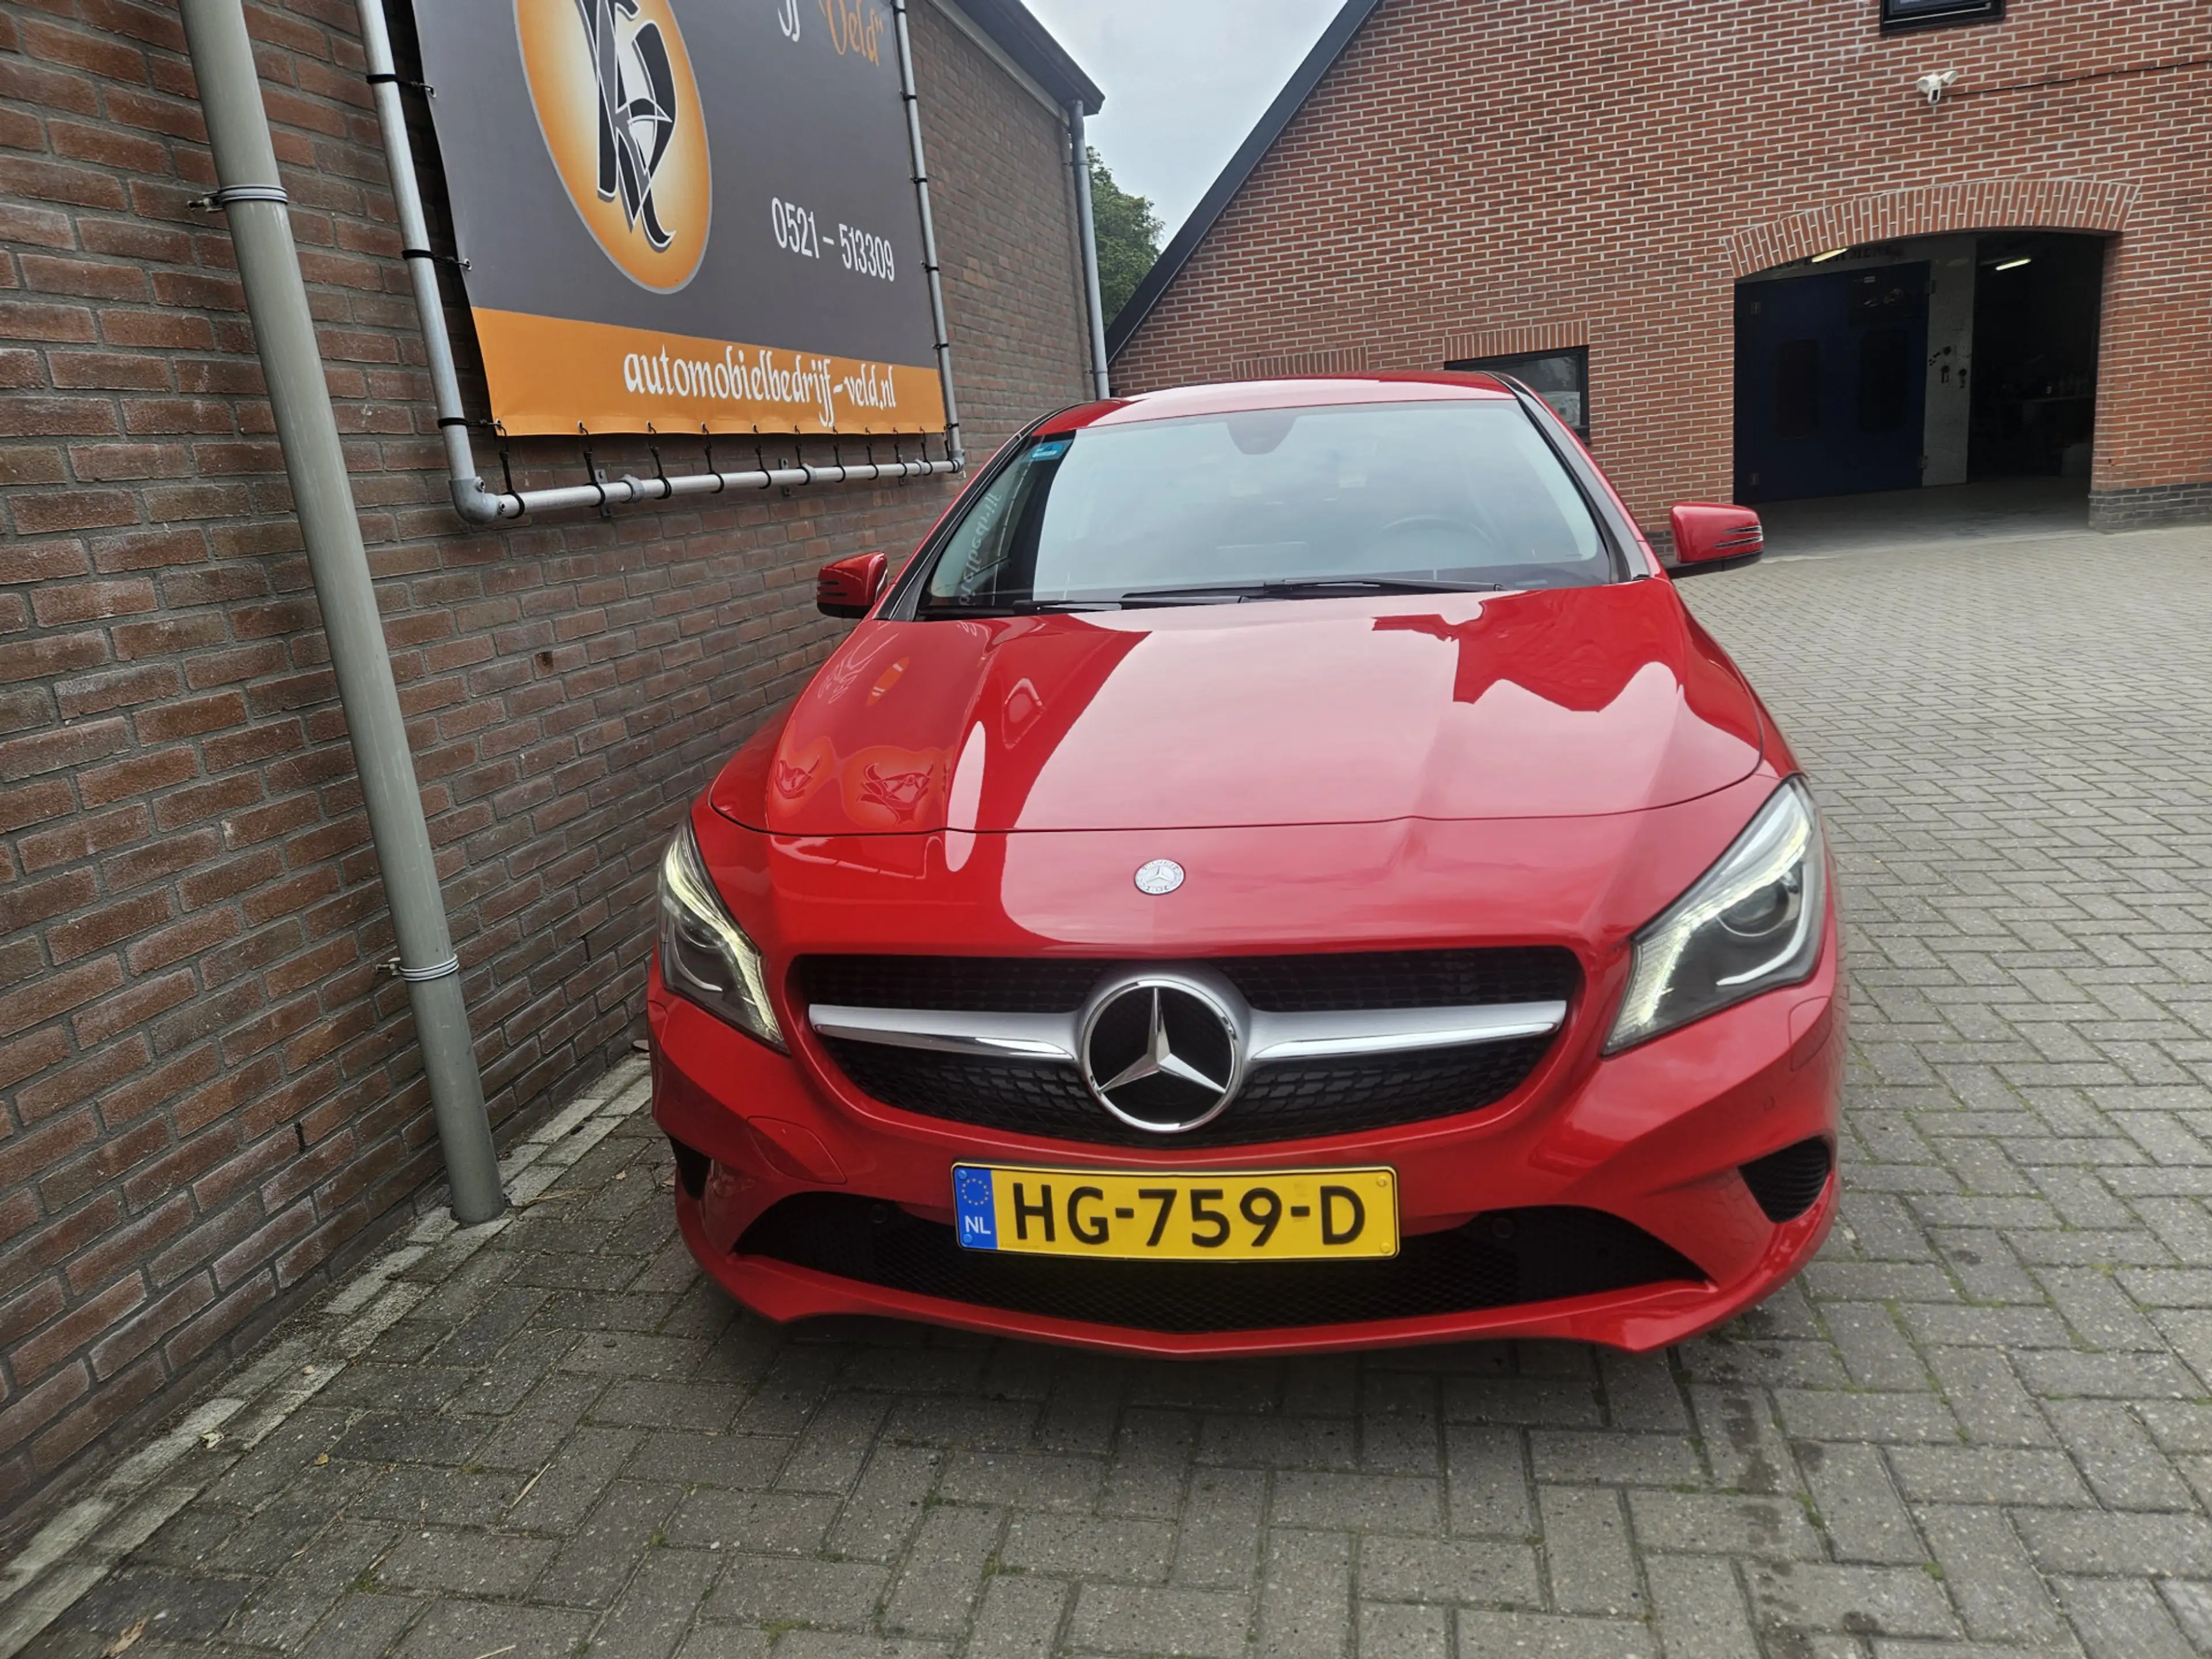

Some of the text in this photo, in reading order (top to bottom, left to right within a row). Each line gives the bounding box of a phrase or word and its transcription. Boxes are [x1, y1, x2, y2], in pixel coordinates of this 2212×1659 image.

[771, 196, 820, 259] 0521
[839, 223, 895, 282] 513309
[623, 344, 896, 427] automobielbedrijf-veld.nl
[964, 1182, 1365, 1248] NL HG-759-D
